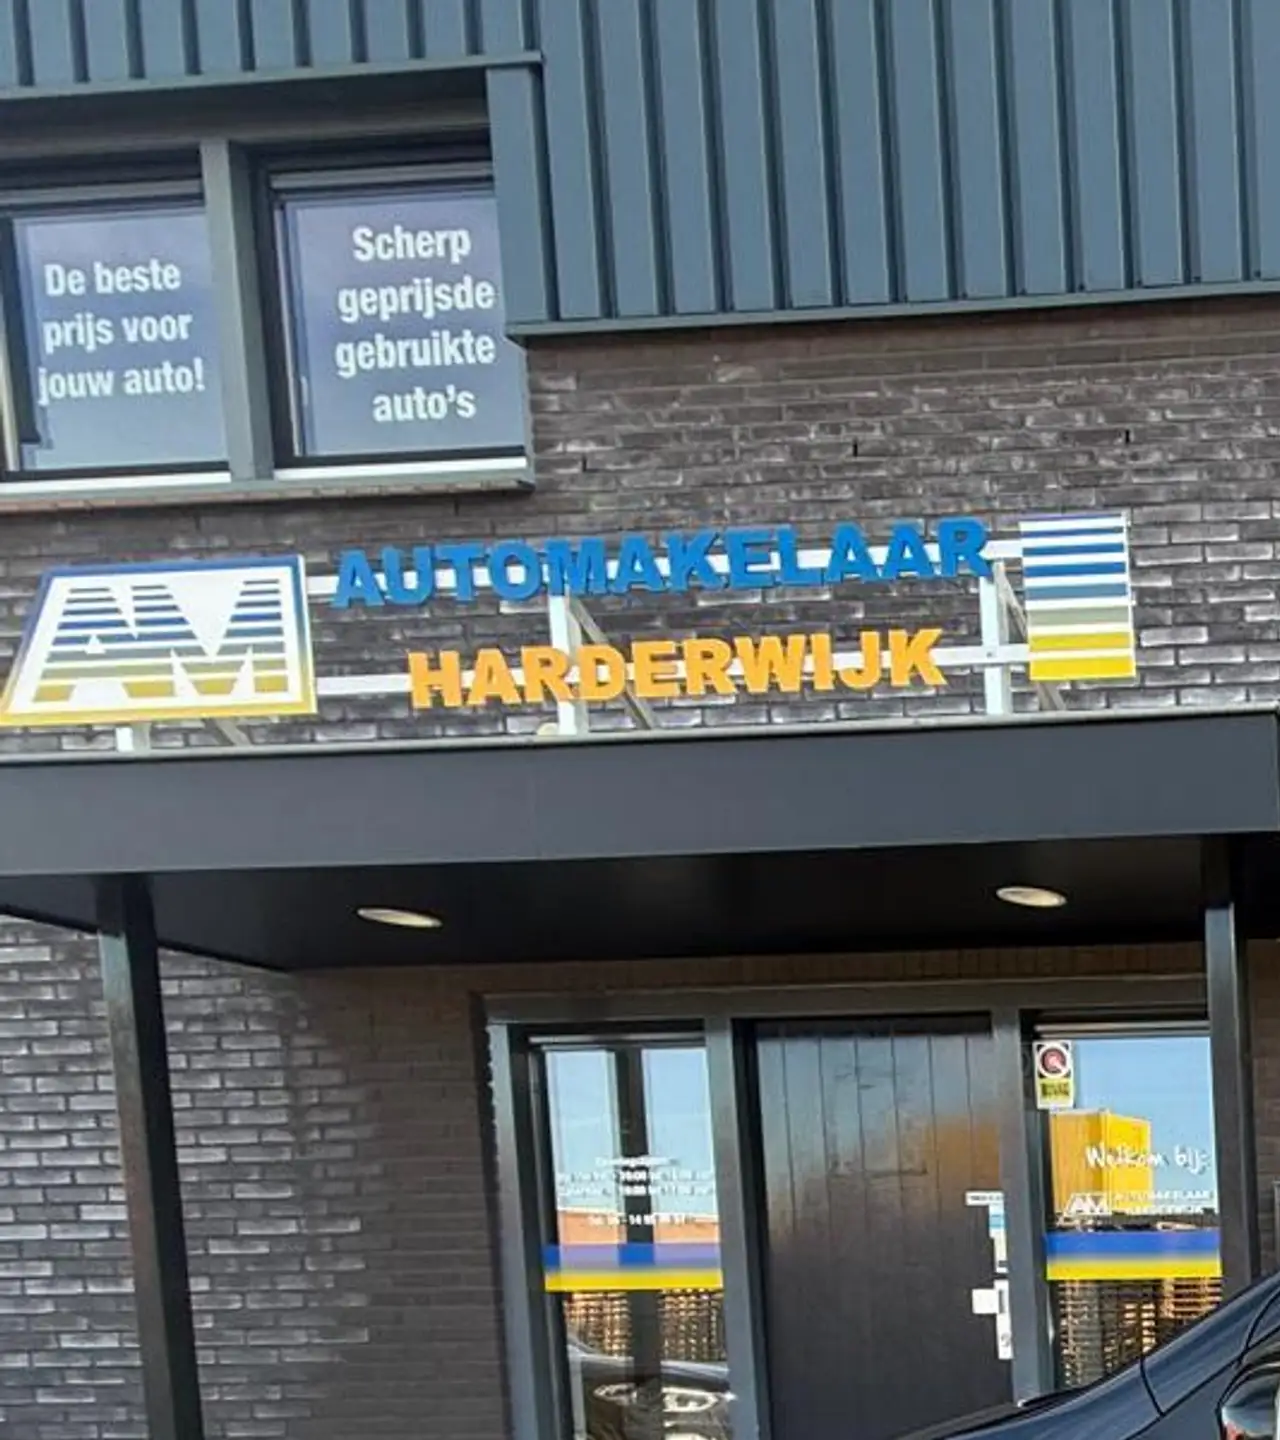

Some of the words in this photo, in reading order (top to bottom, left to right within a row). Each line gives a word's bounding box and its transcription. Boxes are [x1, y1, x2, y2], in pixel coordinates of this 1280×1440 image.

[352, 226, 471, 264] Scherp
[44, 263, 86, 296] De
[93, 258, 181, 294] beste
[338, 275, 495, 323] geprijsde
[44, 313, 114, 354] prijs
[122, 313, 193, 343] voor
[335, 330, 496, 379] gebruikte
[38, 366, 114, 406] jouw
[124, 358, 206, 396] auto!
[373, 385, 476, 422] auto's
[333, 517, 992, 607] AUTOMAKELAAR
[408, 628, 944, 708] HARDERWIJK
[1085, 1142, 1168, 1169] Welkom
